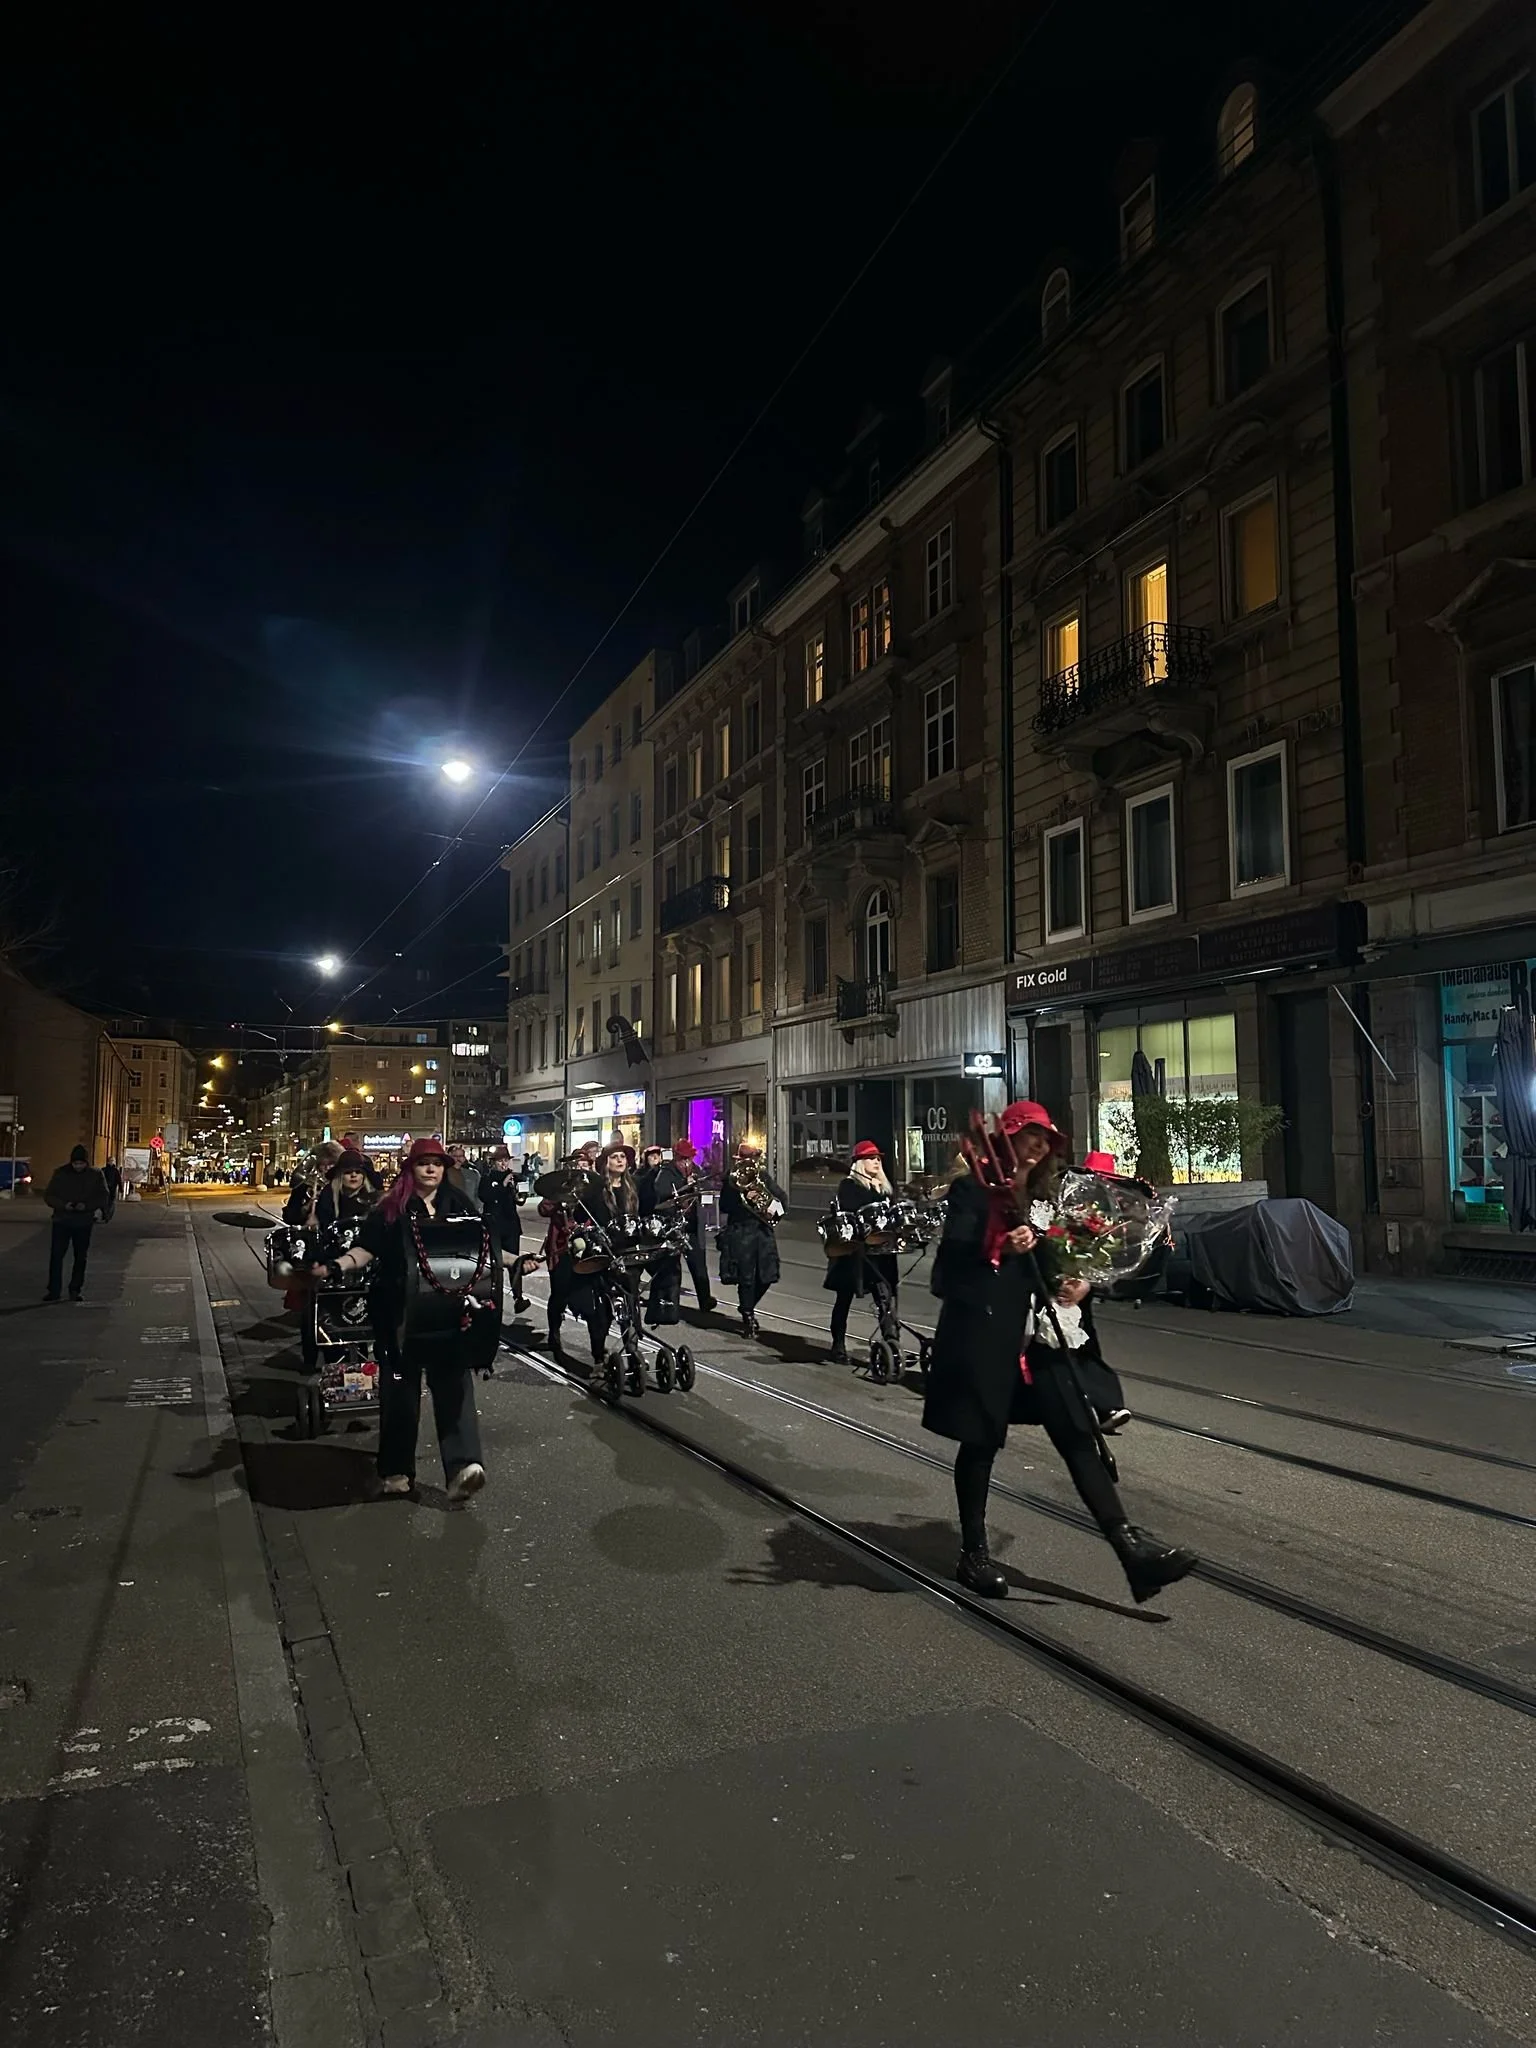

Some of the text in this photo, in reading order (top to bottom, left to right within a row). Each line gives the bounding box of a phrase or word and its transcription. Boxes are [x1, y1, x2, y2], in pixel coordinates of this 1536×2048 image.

[1016, 967, 1067, 989] FIX Gold
[974, 1055, 992, 1067] CG
[927, 1106, 947, 1130] CG
